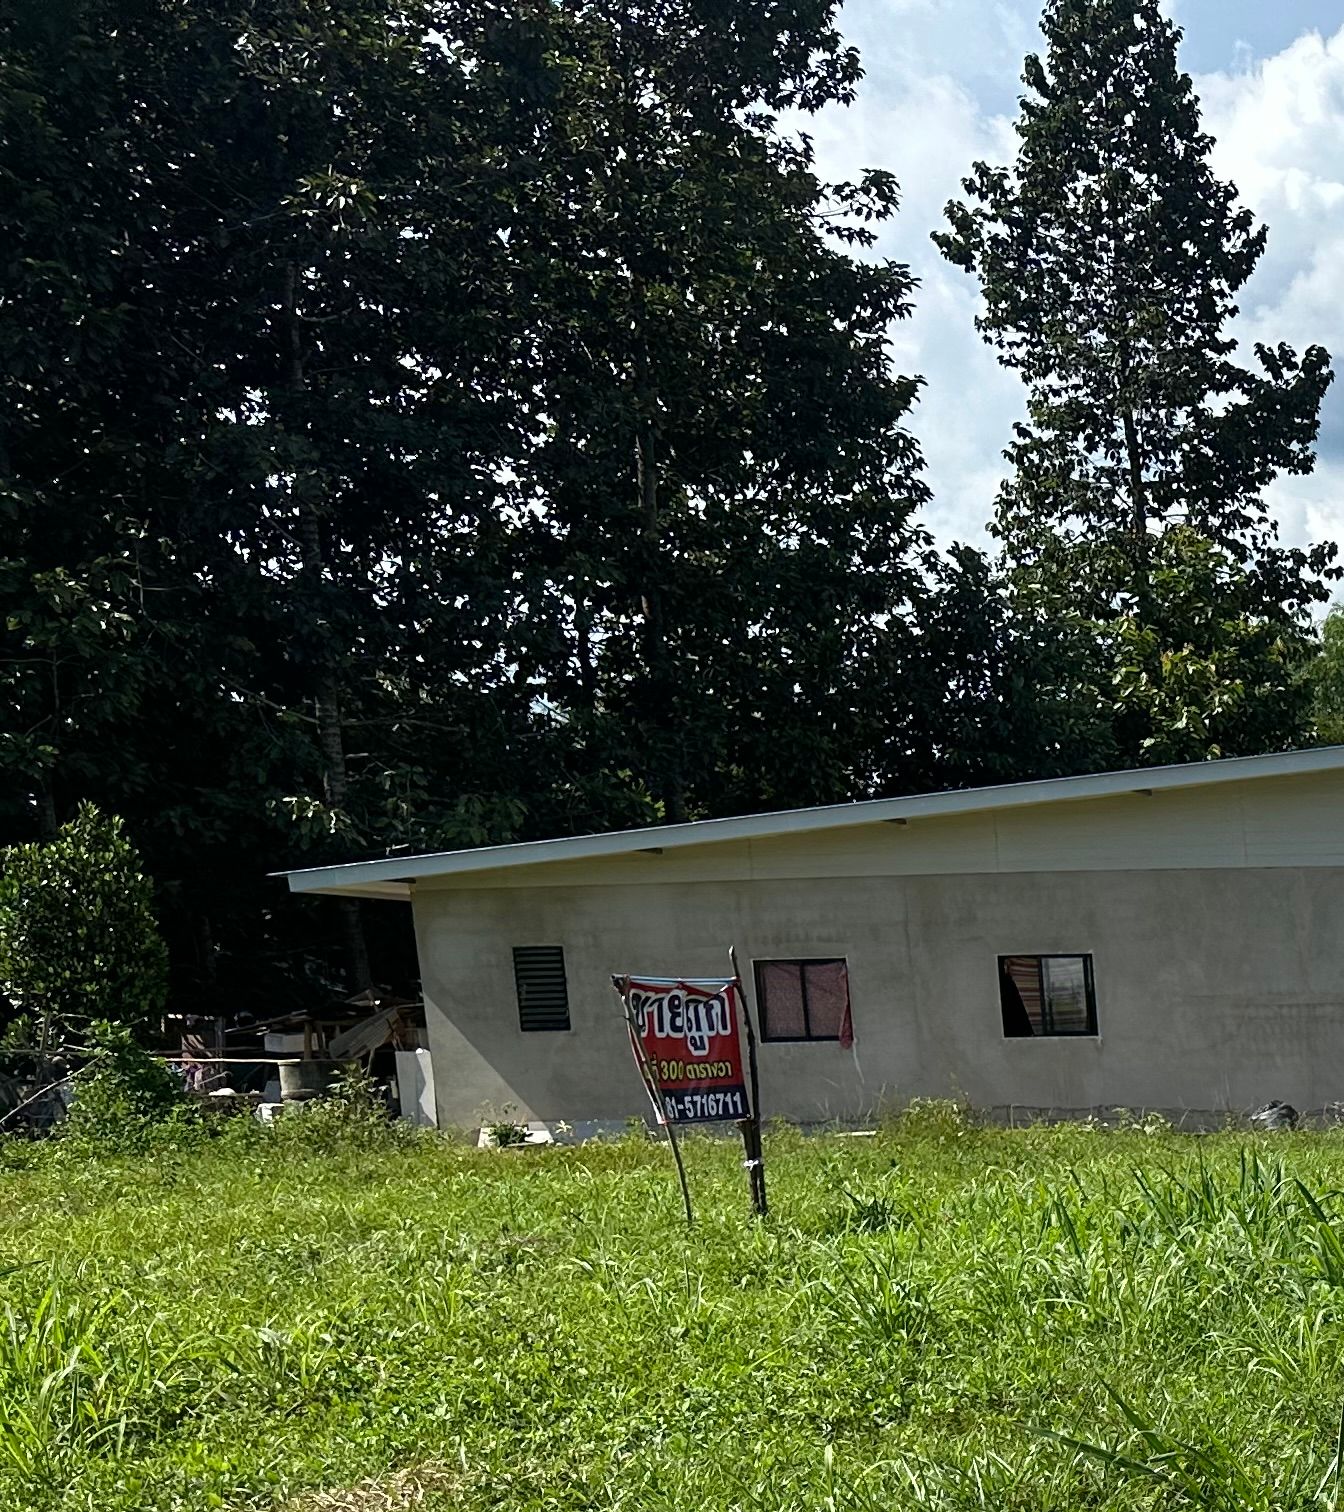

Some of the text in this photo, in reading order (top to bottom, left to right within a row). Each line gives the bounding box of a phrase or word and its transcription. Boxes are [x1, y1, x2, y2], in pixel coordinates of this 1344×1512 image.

[630, 989, 731, 1056] ขายถูก
[660, 1060, 684, 1080] 300
[657, 1092, 743, 1119] 81-5716711
